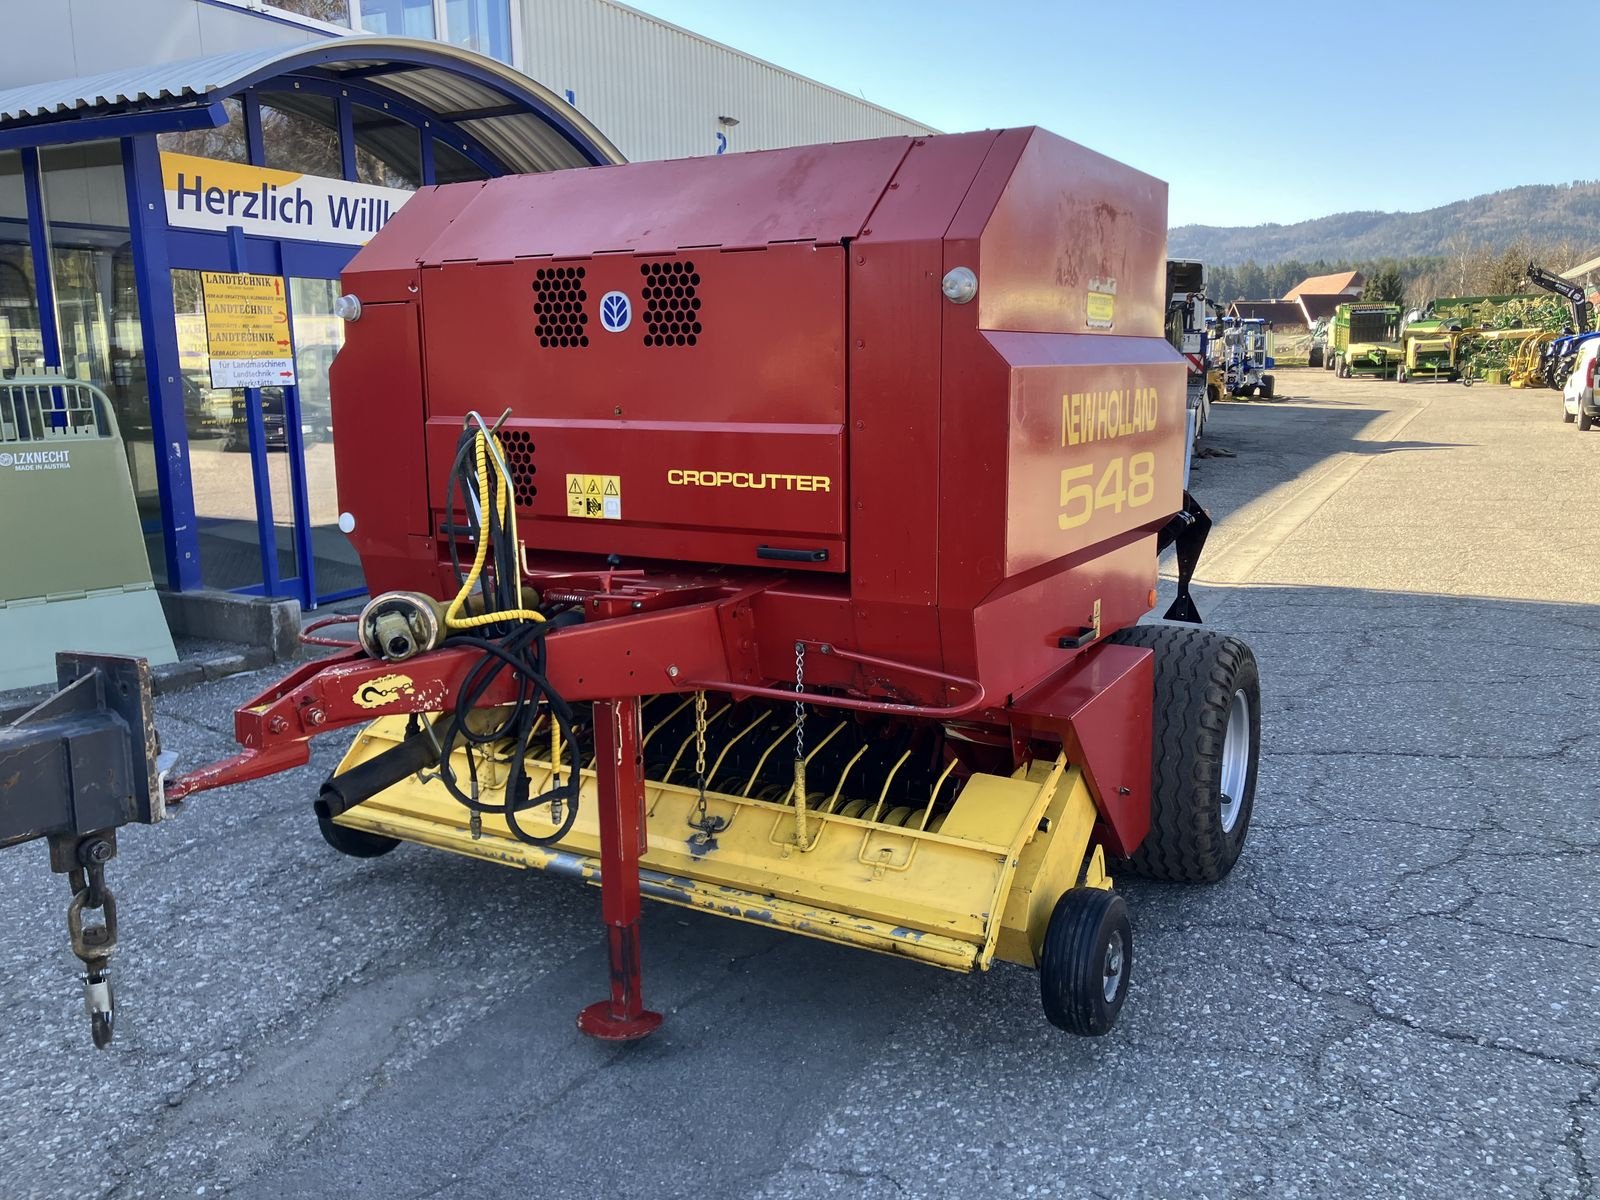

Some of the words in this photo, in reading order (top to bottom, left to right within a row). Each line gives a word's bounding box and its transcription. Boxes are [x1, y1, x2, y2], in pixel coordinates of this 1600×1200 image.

[177, 173, 313, 225] Herzlich
[206, 274, 272, 287] LANDTECHNIK
[207, 304, 273, 315] LANDTECHNIK
[209, 333, 275, 342] LANDTECHNIK
[219, 360, 230, 369] für
[232, 360, 287, 369] Landmaschinen
[43, 462, 71, 470] AUSTRIA
[667, 469, 831, 492] CROPCUTTER
[1058, 452, 1155, 530] 548
